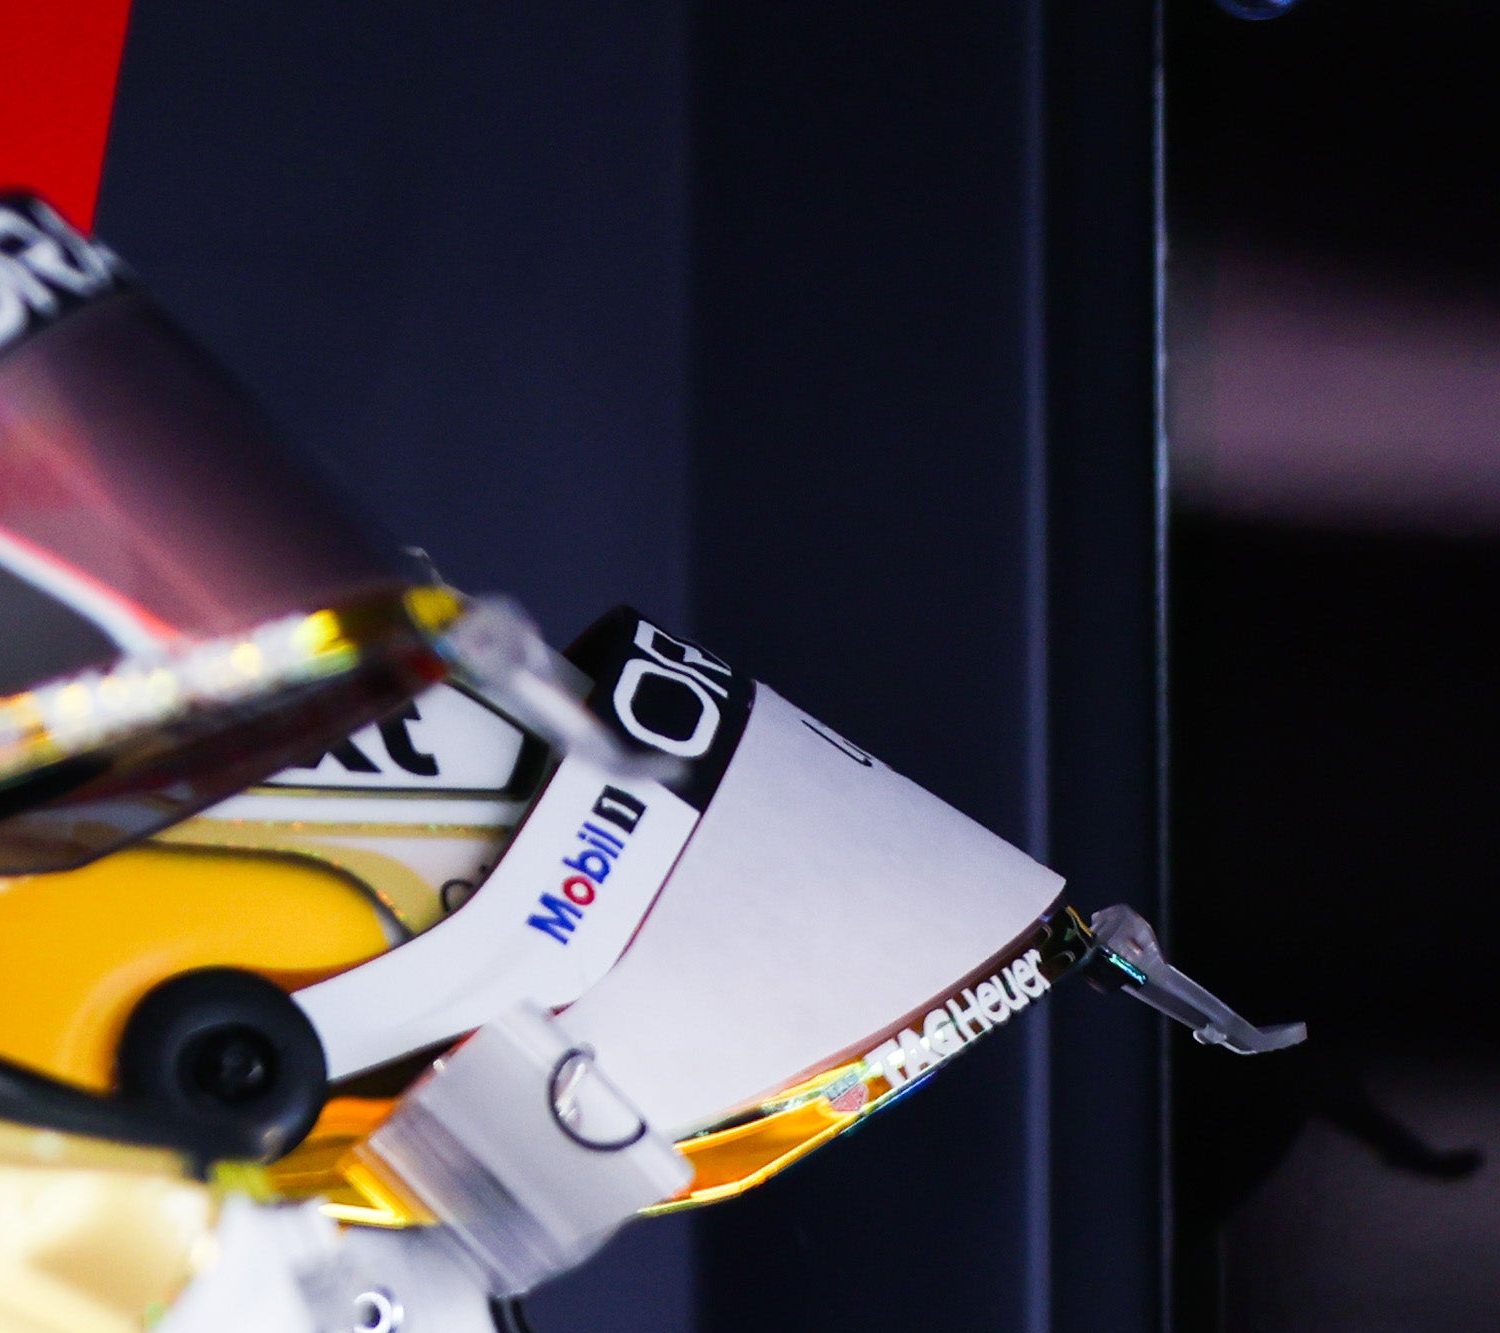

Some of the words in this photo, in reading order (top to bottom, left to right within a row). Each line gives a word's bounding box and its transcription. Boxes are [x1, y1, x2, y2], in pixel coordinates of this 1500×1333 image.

[526, 821, 626, 945] Mobil
[862, 1007, 967, 1089] TAG
[946, 948, 1051, 1041] Heuer
